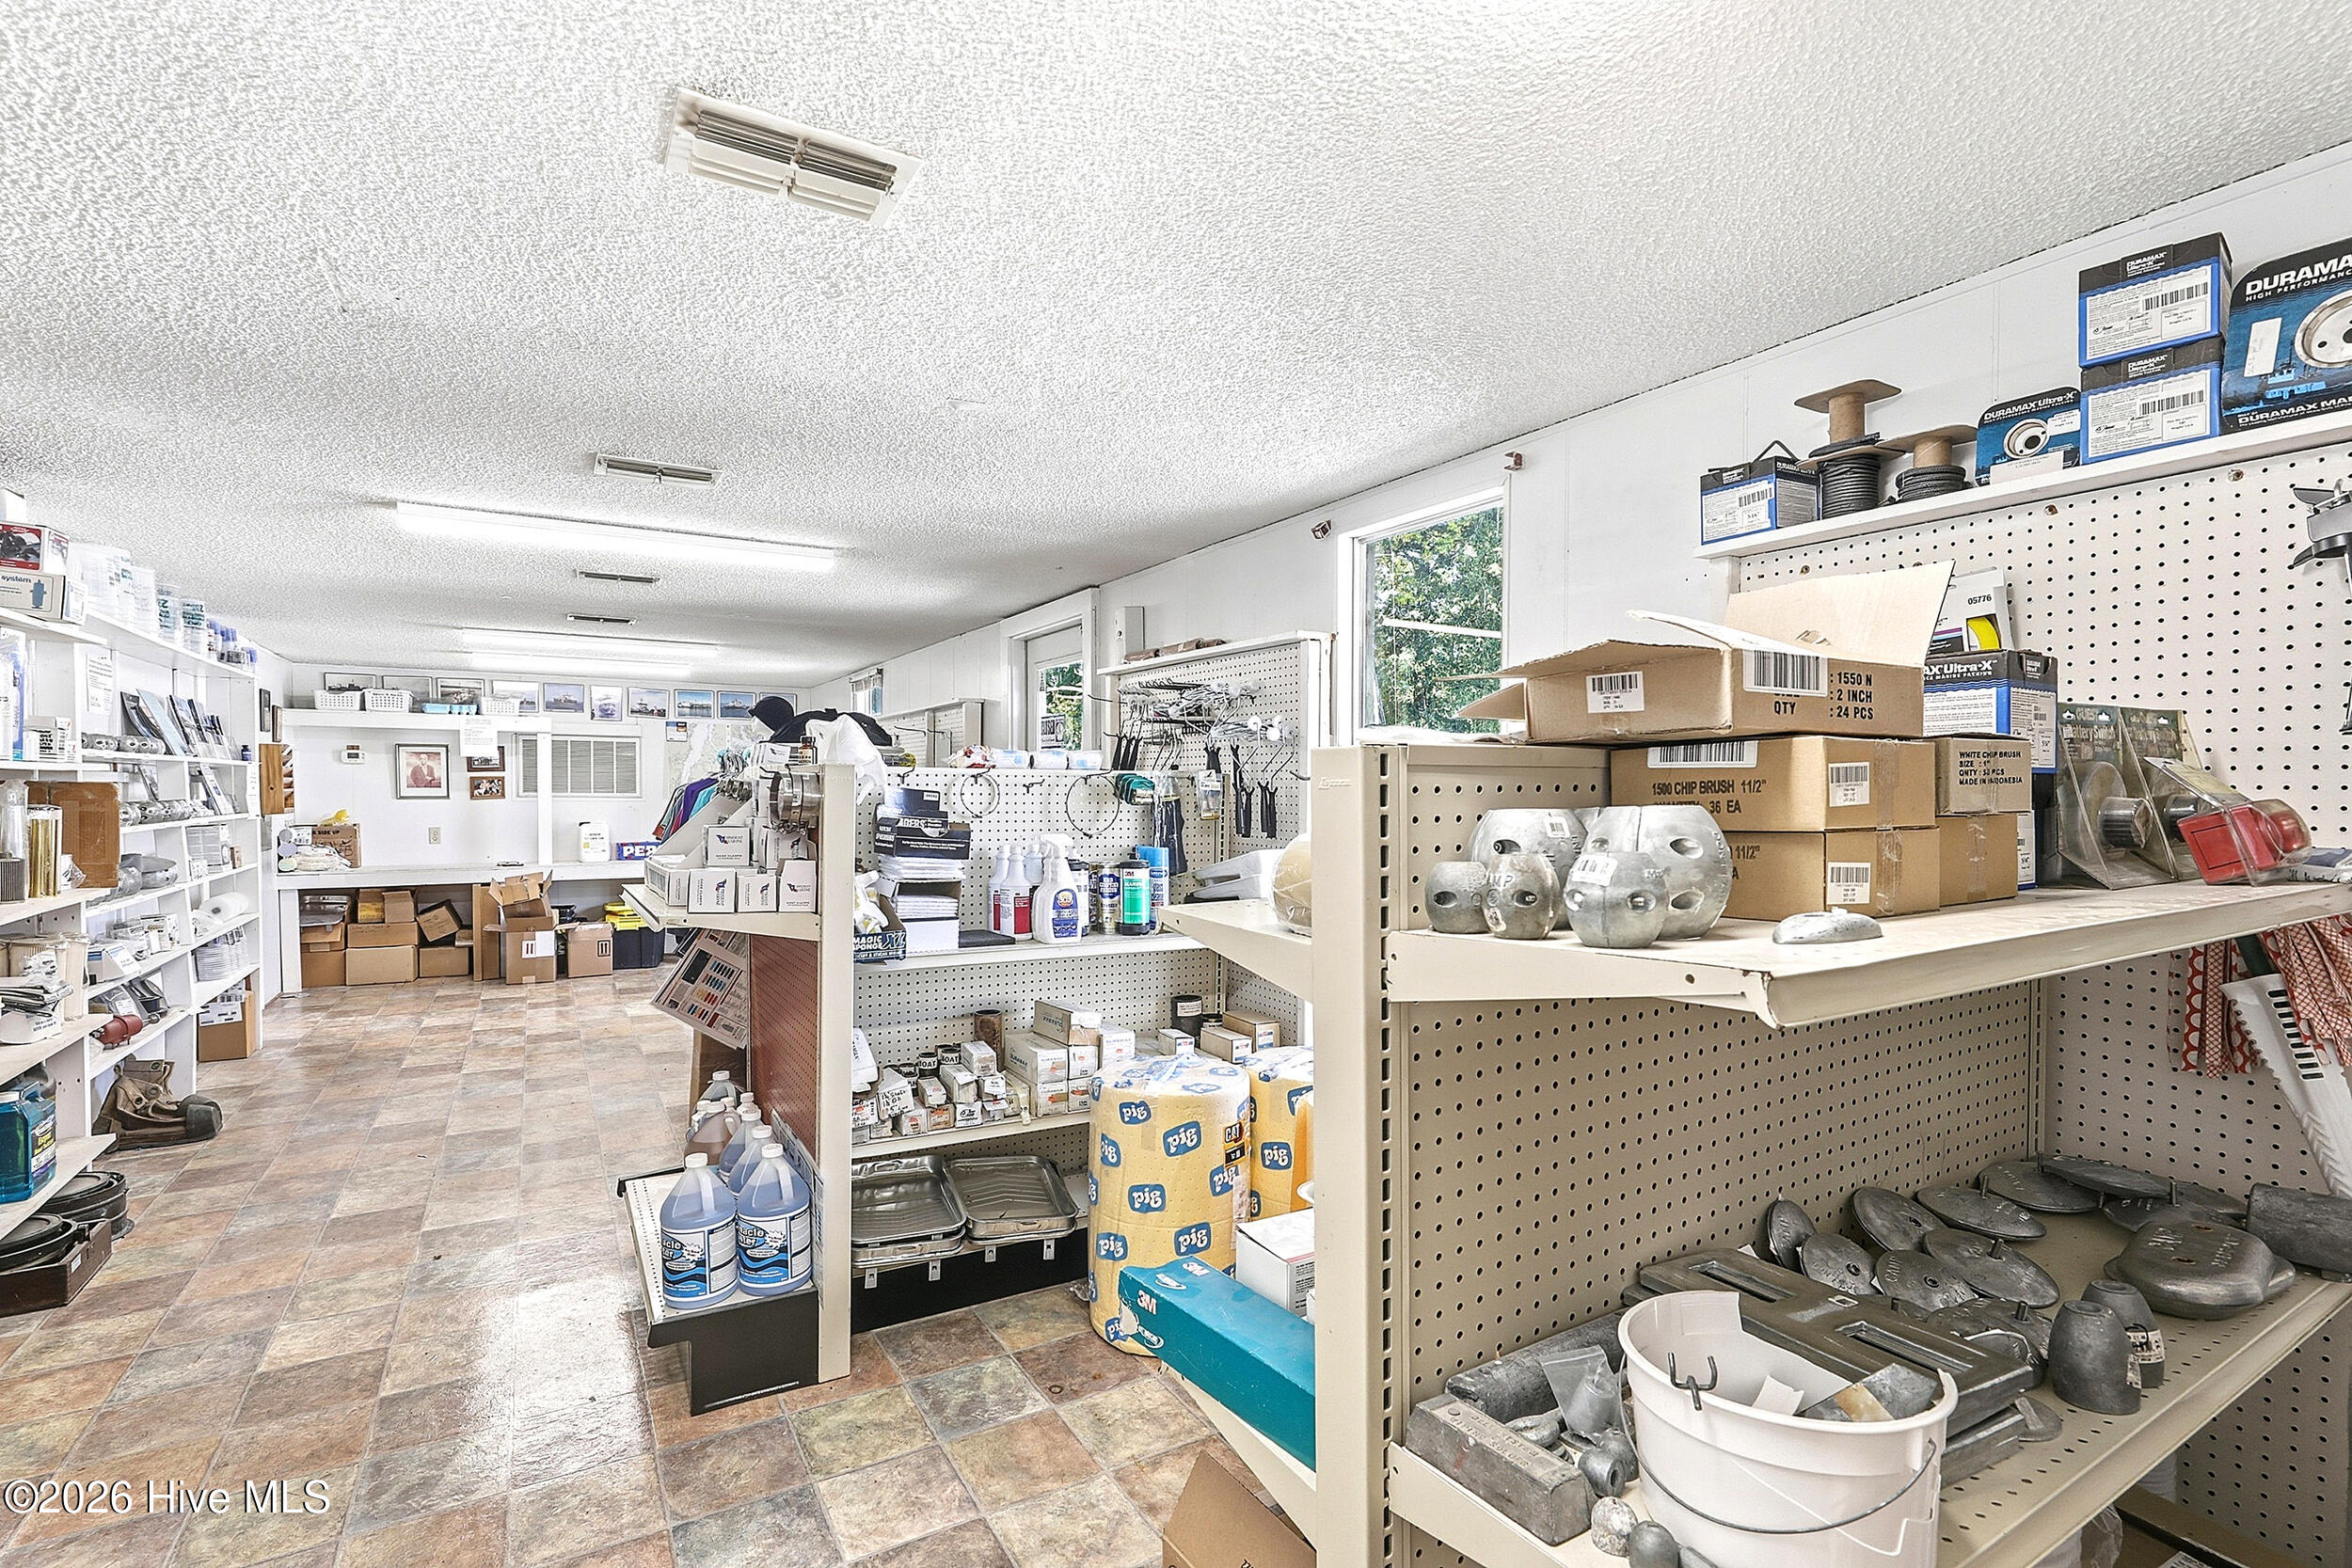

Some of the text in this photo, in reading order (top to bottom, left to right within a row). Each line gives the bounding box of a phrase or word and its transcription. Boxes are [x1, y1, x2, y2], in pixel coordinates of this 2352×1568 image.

[2126, 251, 2168, 268] DURAMAX
[2245, 291, 2272, 302] HIGH
[2127, 354, 2169, 369] DURAMAX
[1983, 401, 2038, 420] DURAMAX
[2238, 403, 2318, 423] DURAMAX
[1967, 594, 1993, 606] 05776
[1836, 672, 1863, 686] 1550
[1865, 674, 1873, 687] N
[1836, 689, 1843, 702] 2
[1847, 689, 1873, 704] INCH
[1773, 701, 1797, 715] QTY
[1836, 705, 1850, 719] 24
[1853, 707, 1874, 720] PCS
[1959, 751, 1981, 759] WHITE
[1998, 751, 2022, 759] BRUSH
[1959, 760, 1975, 768] SIZE
[1991, 768, 2005, 776] PCS
[1652, 782, 1673, 796] 1500
[1674, 781, 1697, 795] CHIP
[1699, 779, 1735, 794] BRUSH
[1959, 778, 1979, 786] MADE
[1987, 777, 2023, 785] INDONESIA
[1708, 800, 1742, 815] 36 EA
[853, 935, 882, 944] MAGIC
[1121, 1104, 1147, 1122] pig
[1166, 1127, 1200, 1154] pig
[1225, 1123, 1242, 1144] CAT
[1263, 1145, 1290, 1166] pig
[1131, 1186, 1163, 1211] pig
[1098, 1237, 1124, 1259] pig
[1178, 1226, 1209, 1256] pig
[1136, 1289, 1157, 1315] 3M
